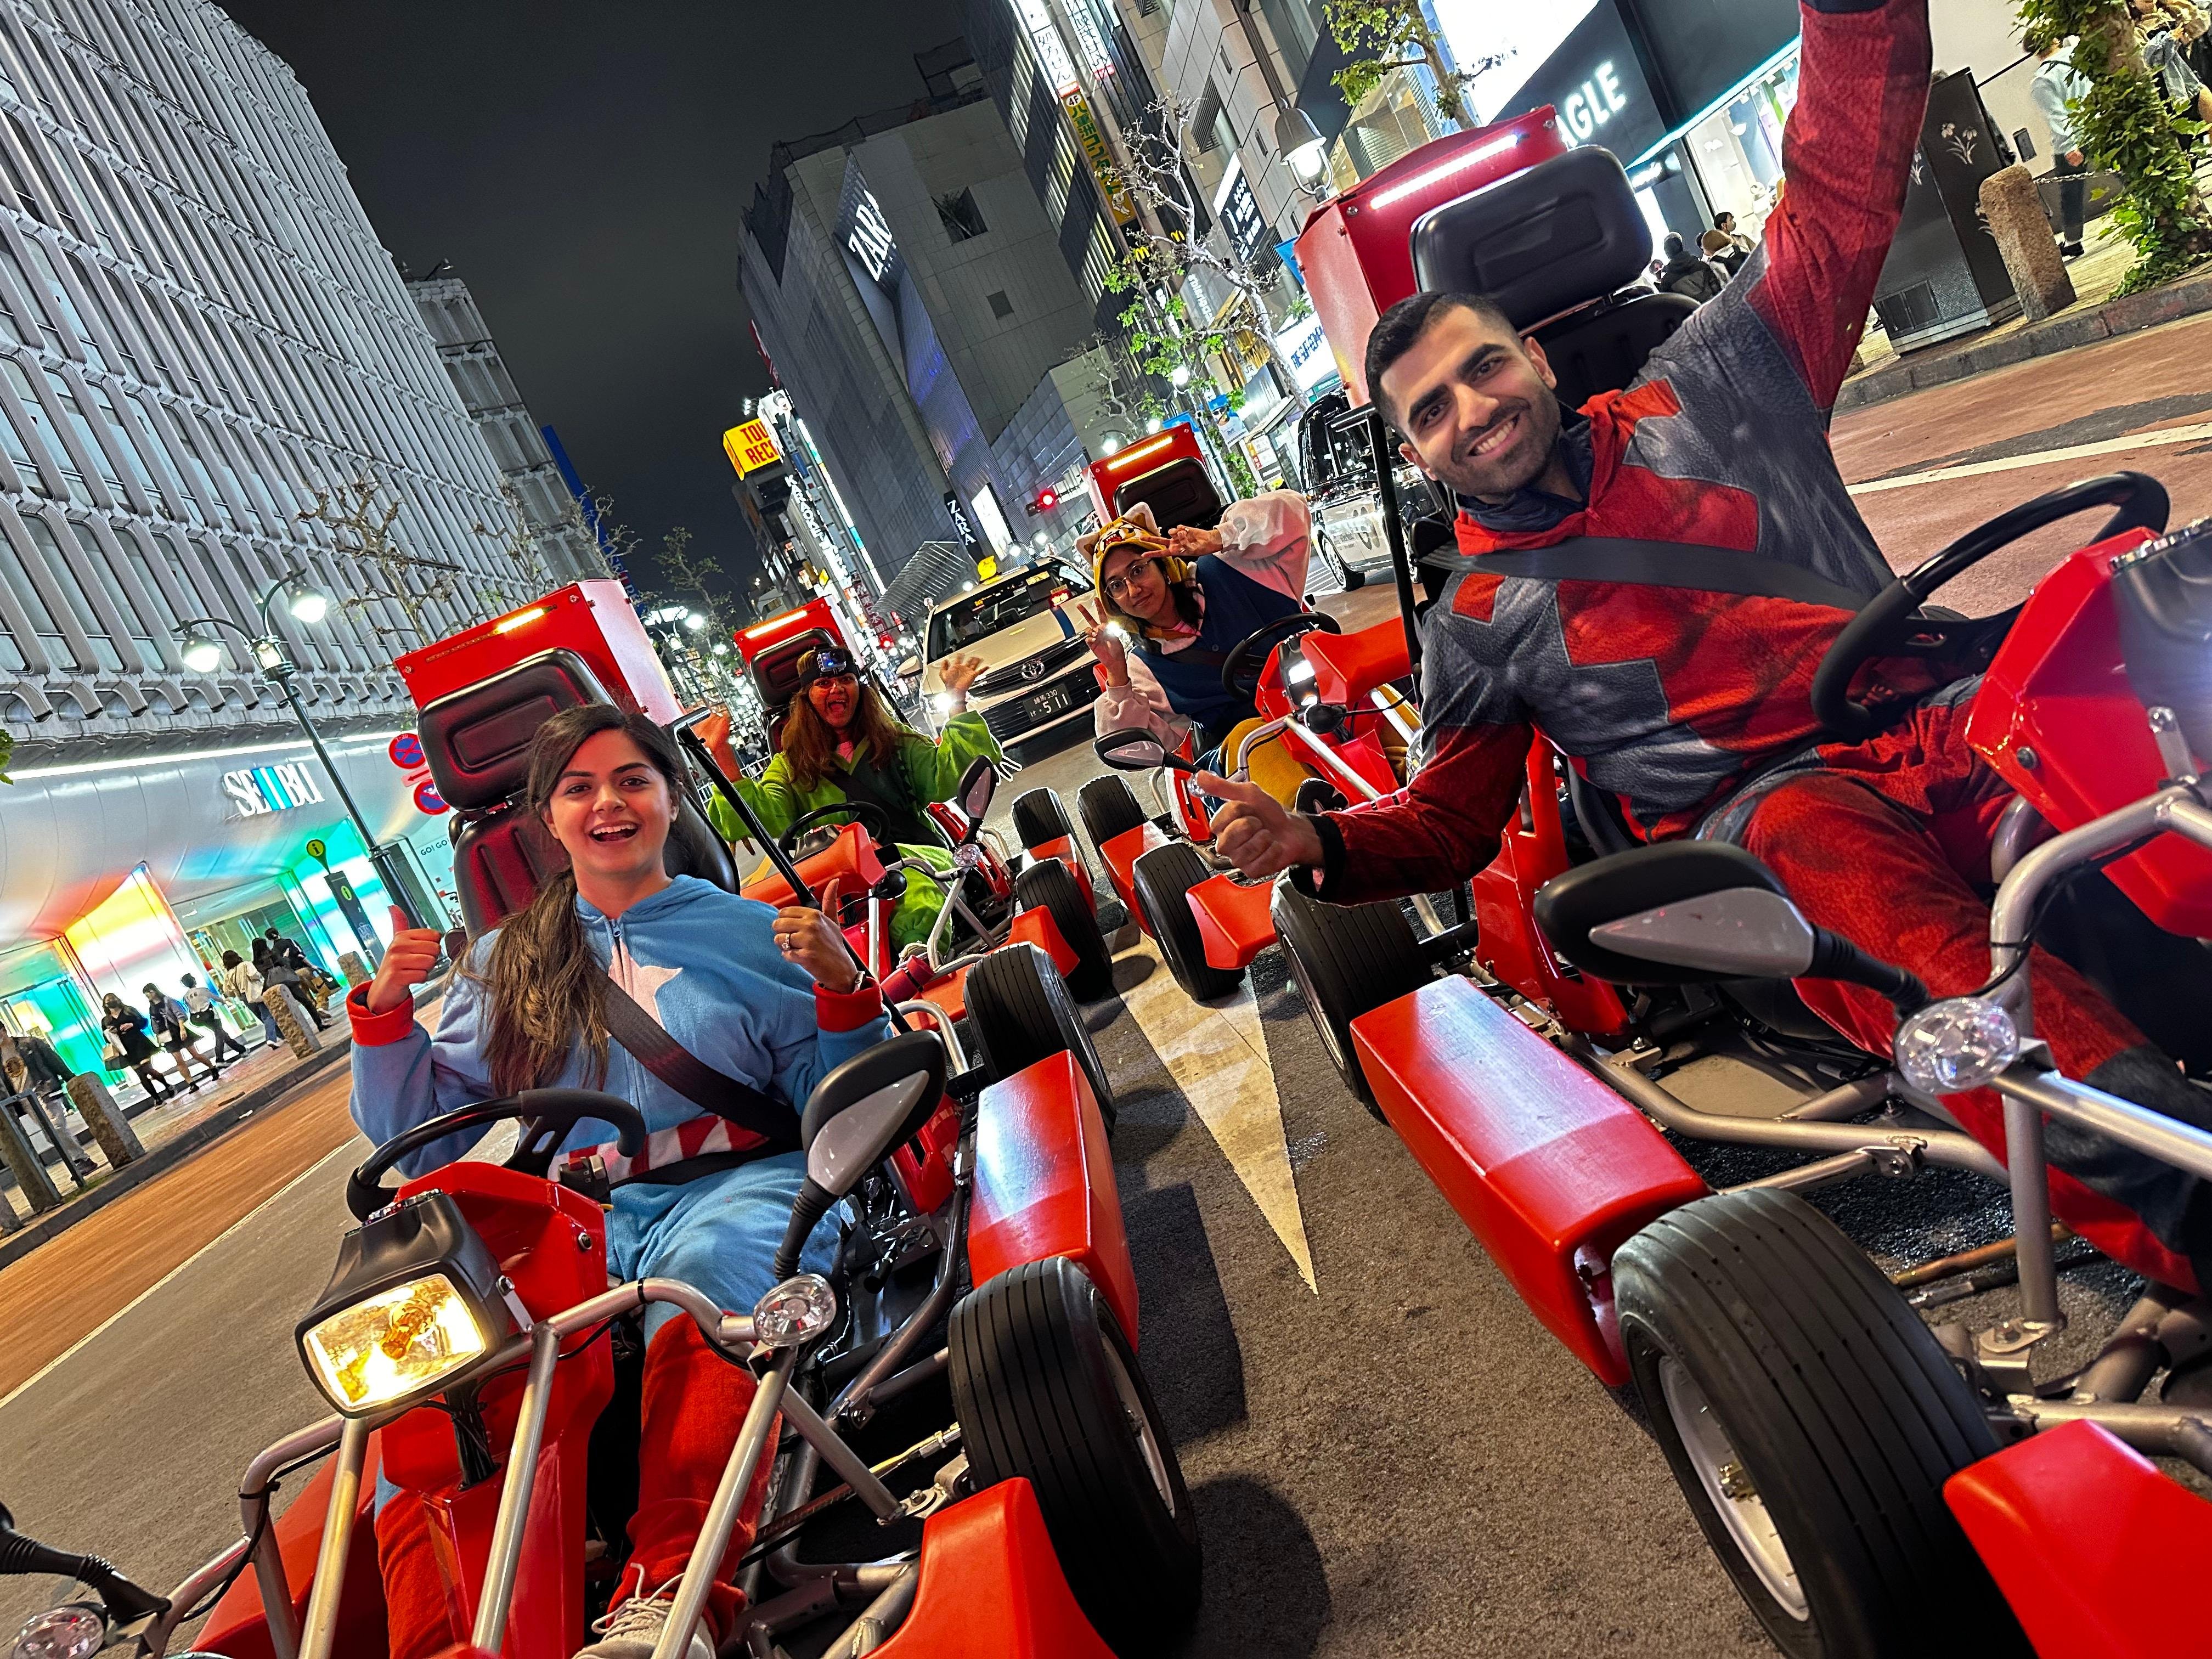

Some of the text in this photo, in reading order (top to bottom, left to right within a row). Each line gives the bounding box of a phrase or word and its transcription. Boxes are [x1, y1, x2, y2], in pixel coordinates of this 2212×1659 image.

[1037, 32, 1070, 84] 処方せん
[1069, 95, 1080, 106] 4F
[785, 475, 822, 538] KARAOKE
[947, 499, 976, 546] ZARA
[1046, 689, 1058, 699] 330
[224, 762, 326, 817] SEIBU
